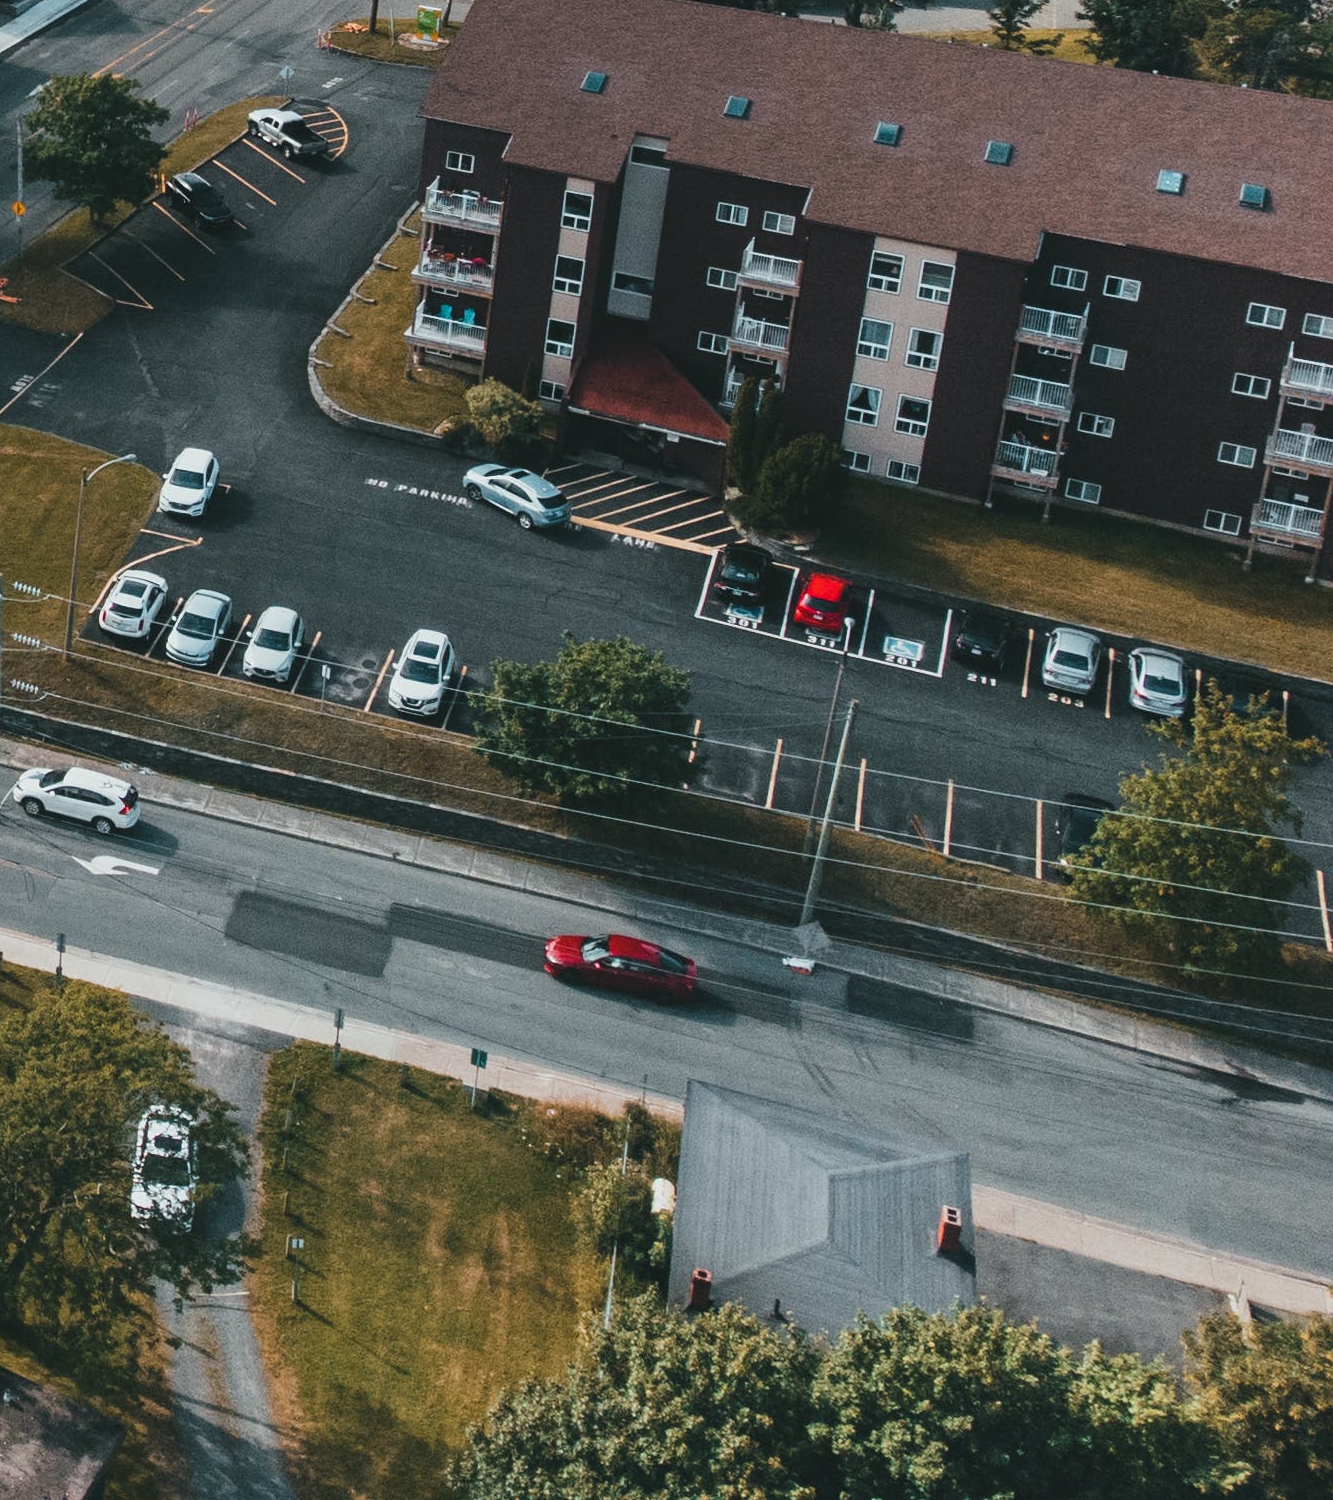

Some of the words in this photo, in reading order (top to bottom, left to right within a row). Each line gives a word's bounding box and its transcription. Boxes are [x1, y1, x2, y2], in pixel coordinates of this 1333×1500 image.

[365, 478, 388, 488] NO
[396, 484, 472, 508] PARKING
[727, 616, 758, 629] 301
[807, 635, 835, 648] 311
[884, 654, 918, 668] 201
[967, 673, 997, 687] 211
[1048, 692, 1085, 708] 203
